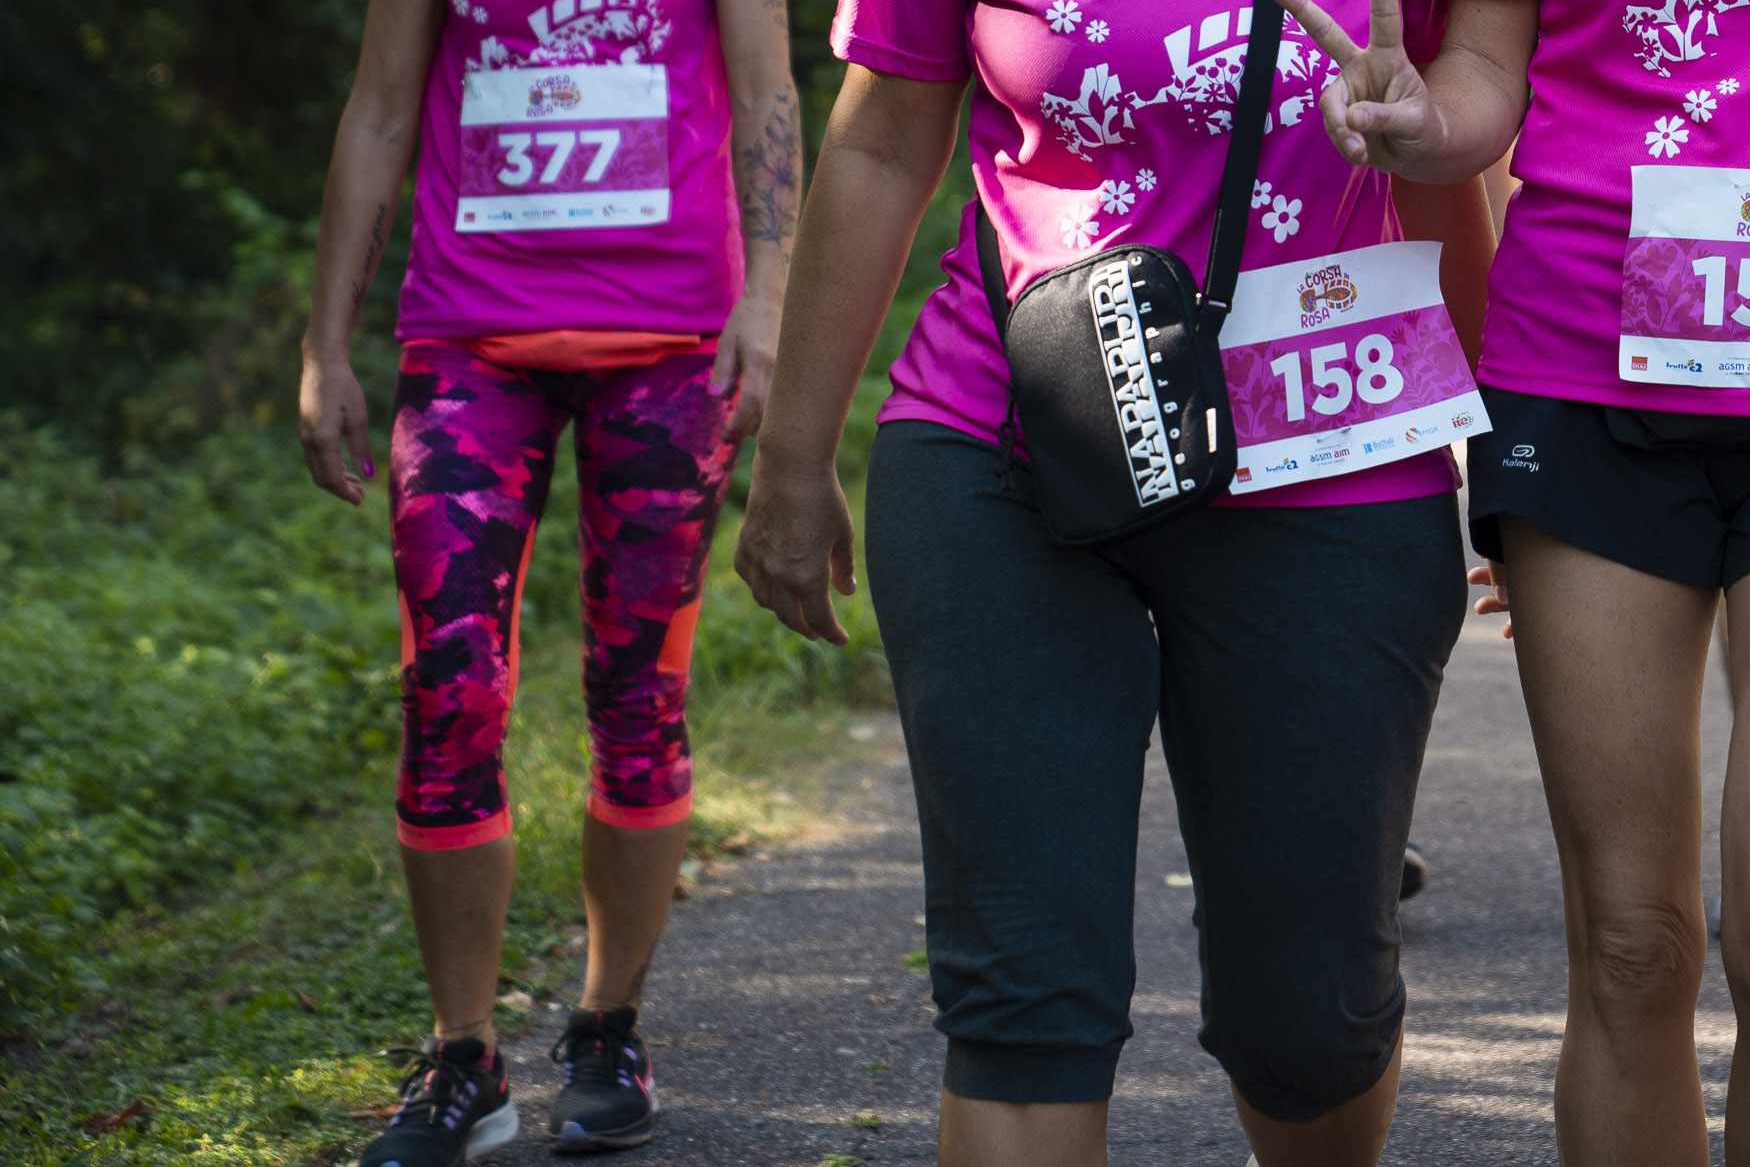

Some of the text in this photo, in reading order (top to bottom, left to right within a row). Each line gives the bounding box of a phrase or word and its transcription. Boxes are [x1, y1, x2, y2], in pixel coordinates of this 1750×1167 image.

[497, 129, 620, 186] 377
[1741, 192, 1750, 202] LA
[1296, 284, 1305, 294] LA
[1305, 265, 1342, 288] CORSA
[1301, 307, 1331, 329] ROSA
[1270, 333, 1404, 422] 158
[1502, 458, 1540, 473] Kalenji
